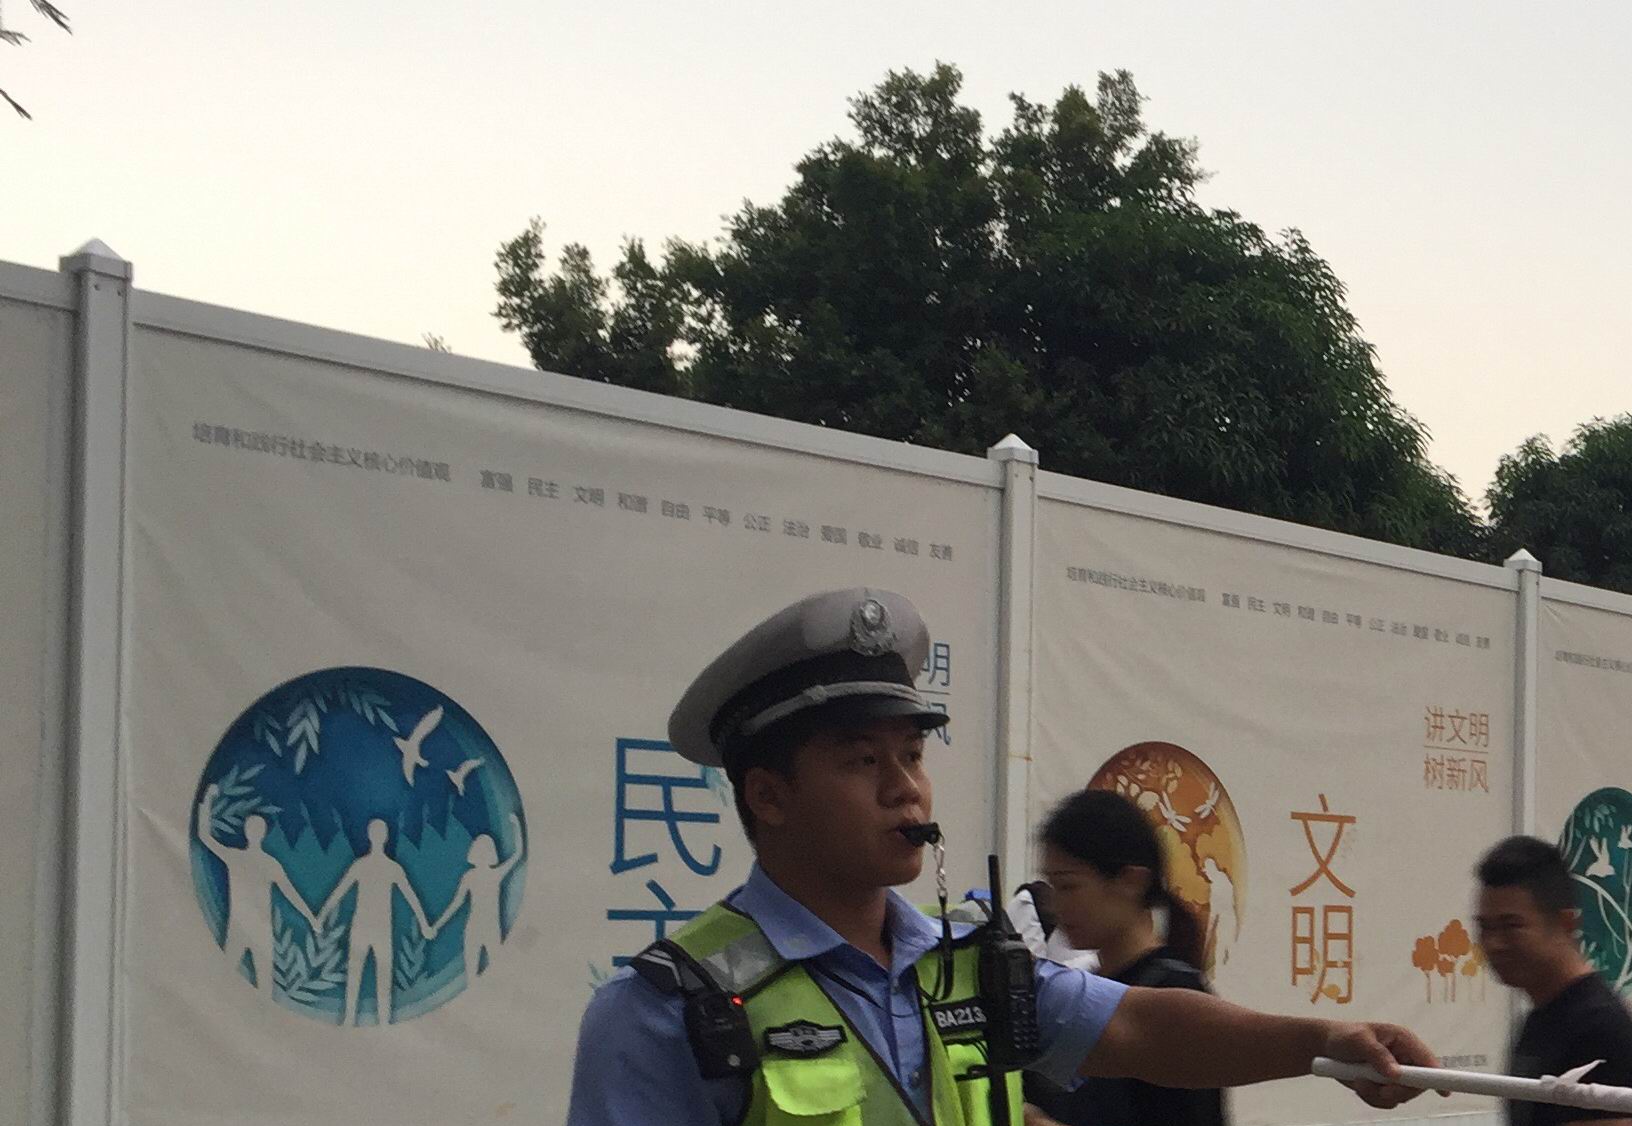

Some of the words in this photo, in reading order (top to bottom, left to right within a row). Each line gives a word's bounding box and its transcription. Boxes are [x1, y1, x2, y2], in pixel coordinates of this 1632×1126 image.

[572, 485, 605, 508] 文明
[1424, 705, 1490, 748] 讲文明
[1423, 753, 1489, 793] 树新风
[1290, 793, 1357, 1004] 文明
